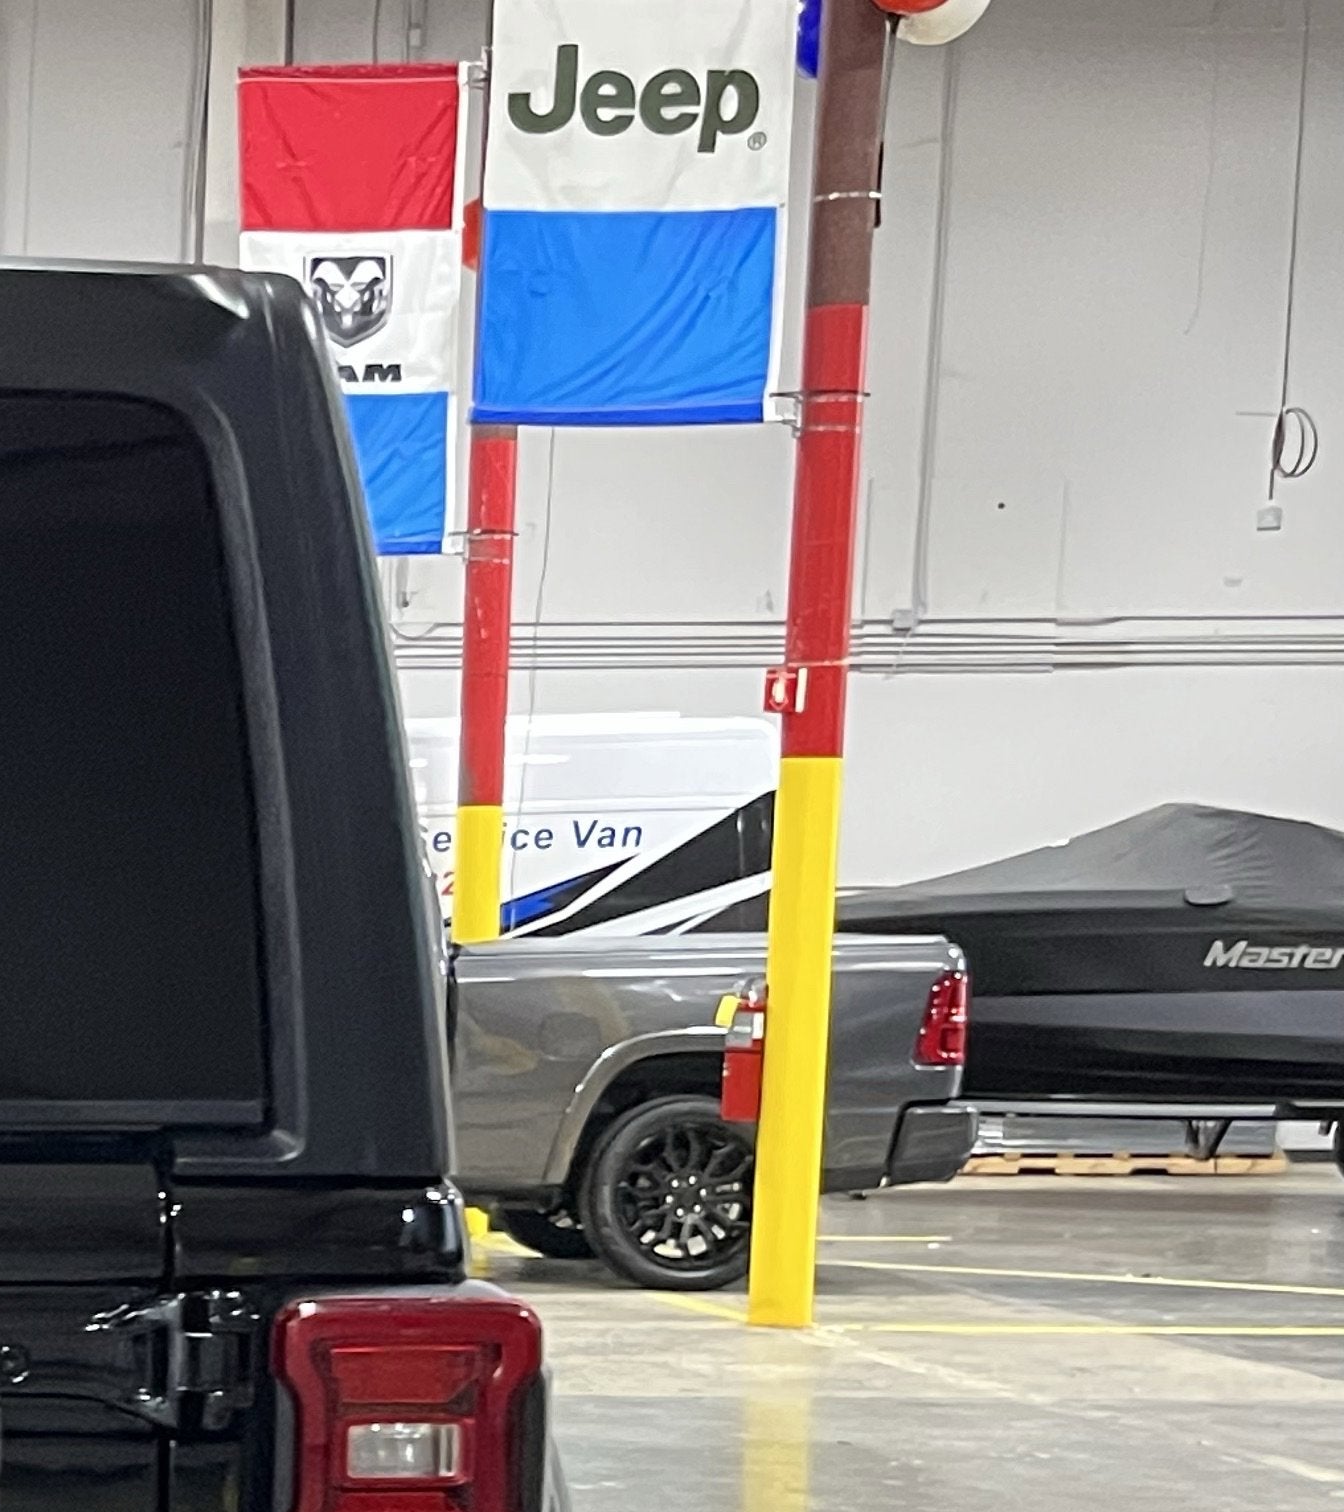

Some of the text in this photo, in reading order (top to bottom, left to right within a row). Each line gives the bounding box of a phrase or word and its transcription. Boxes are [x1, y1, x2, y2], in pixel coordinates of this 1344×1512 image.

[507, 44, 760, 153] Jeep
[337, 363, 402, 383] AM
[419, 819, 643, 851] eice Van
